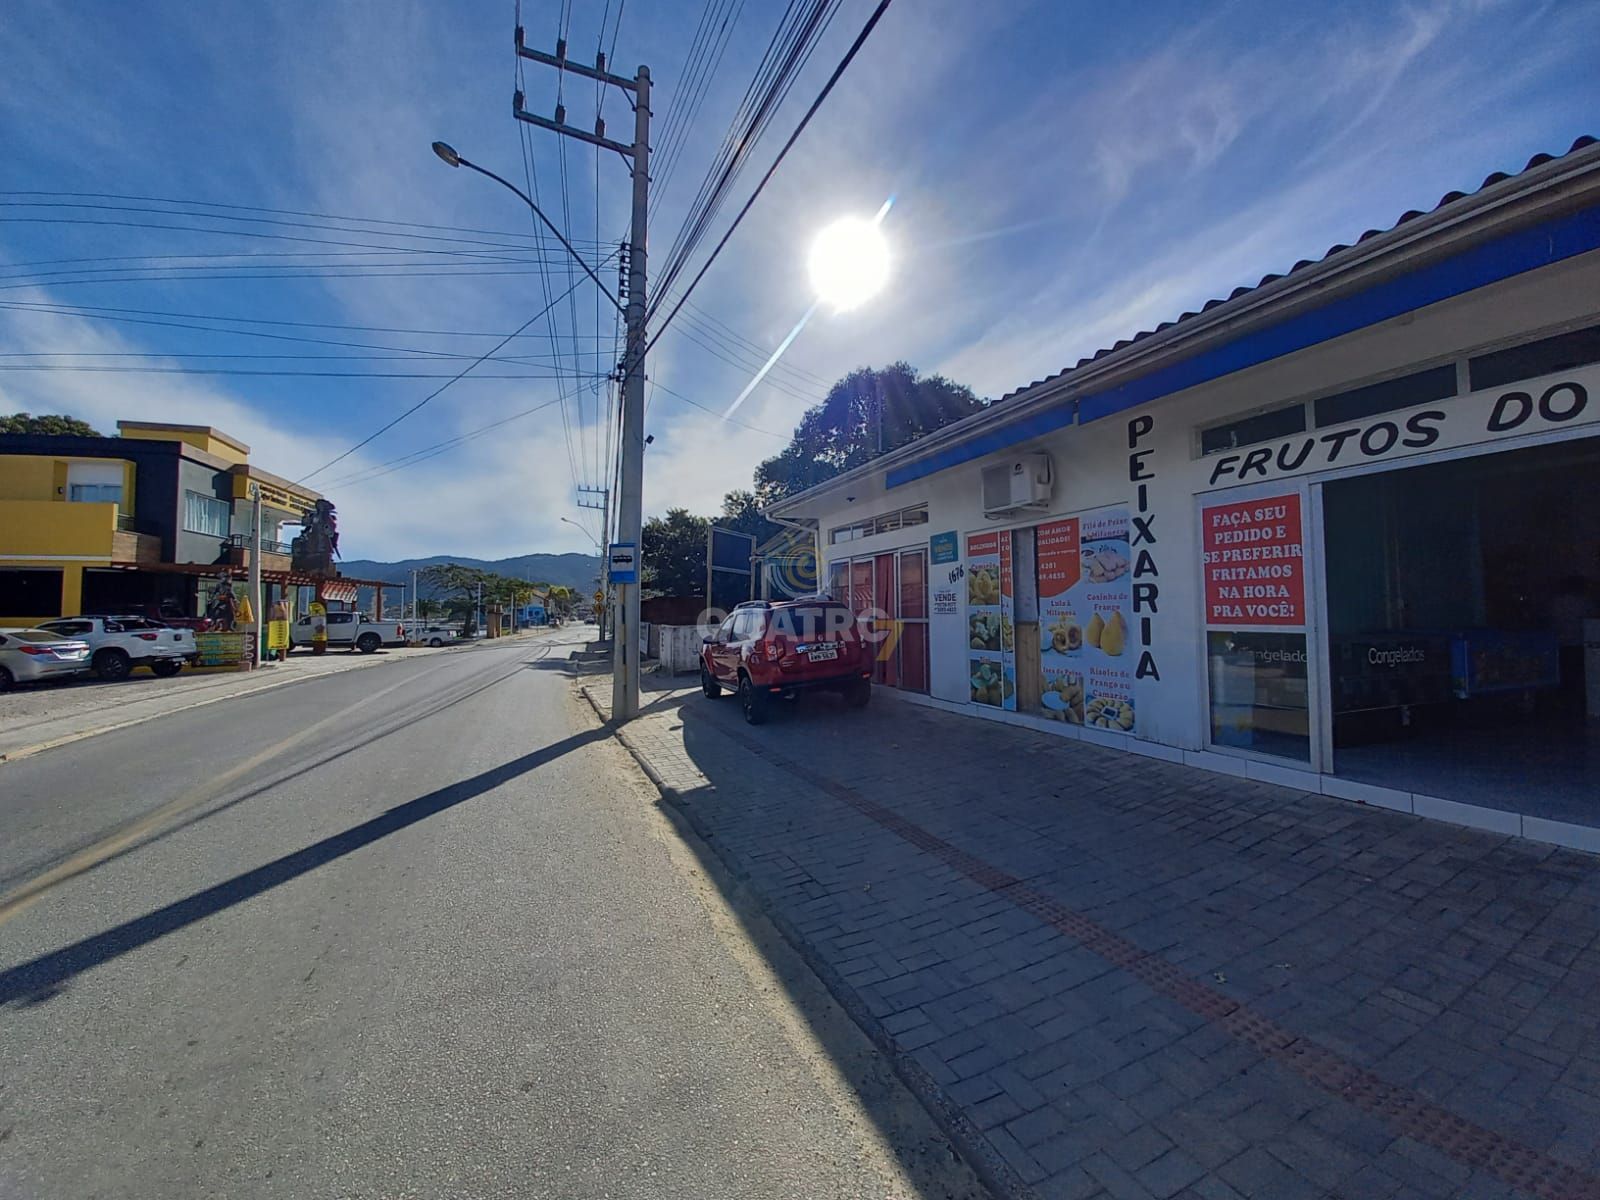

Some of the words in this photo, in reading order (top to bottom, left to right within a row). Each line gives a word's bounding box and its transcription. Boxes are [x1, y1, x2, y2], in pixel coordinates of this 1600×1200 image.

[1209, 411, 1446, 485] FRUTOS
[1486, 382, 1588, 432] DO
[1212, 510, 1251, 528] FAÇA
[1254, 505, 1286, 521] SEU
[1214, 527, 1272, 545] PEDIDO
[1275, 525, 1287, 538] E
[1128, 415, 1160, 681] PEIXARIA
[1203, 551, 1220, 564] SE
[1223, 544, 1304, 562] PREFERIR
[1212, 565, 1292, 581] FRITAMOS
[1218, 586, 1241, 599] NA
[1243, 584, 1290, 598] HORA
[1212, 605, 1243, 617] PRA
[1246, 601, 1295, 617] VOCÊ!
[1367, 647, 1425, 667] Congelados
